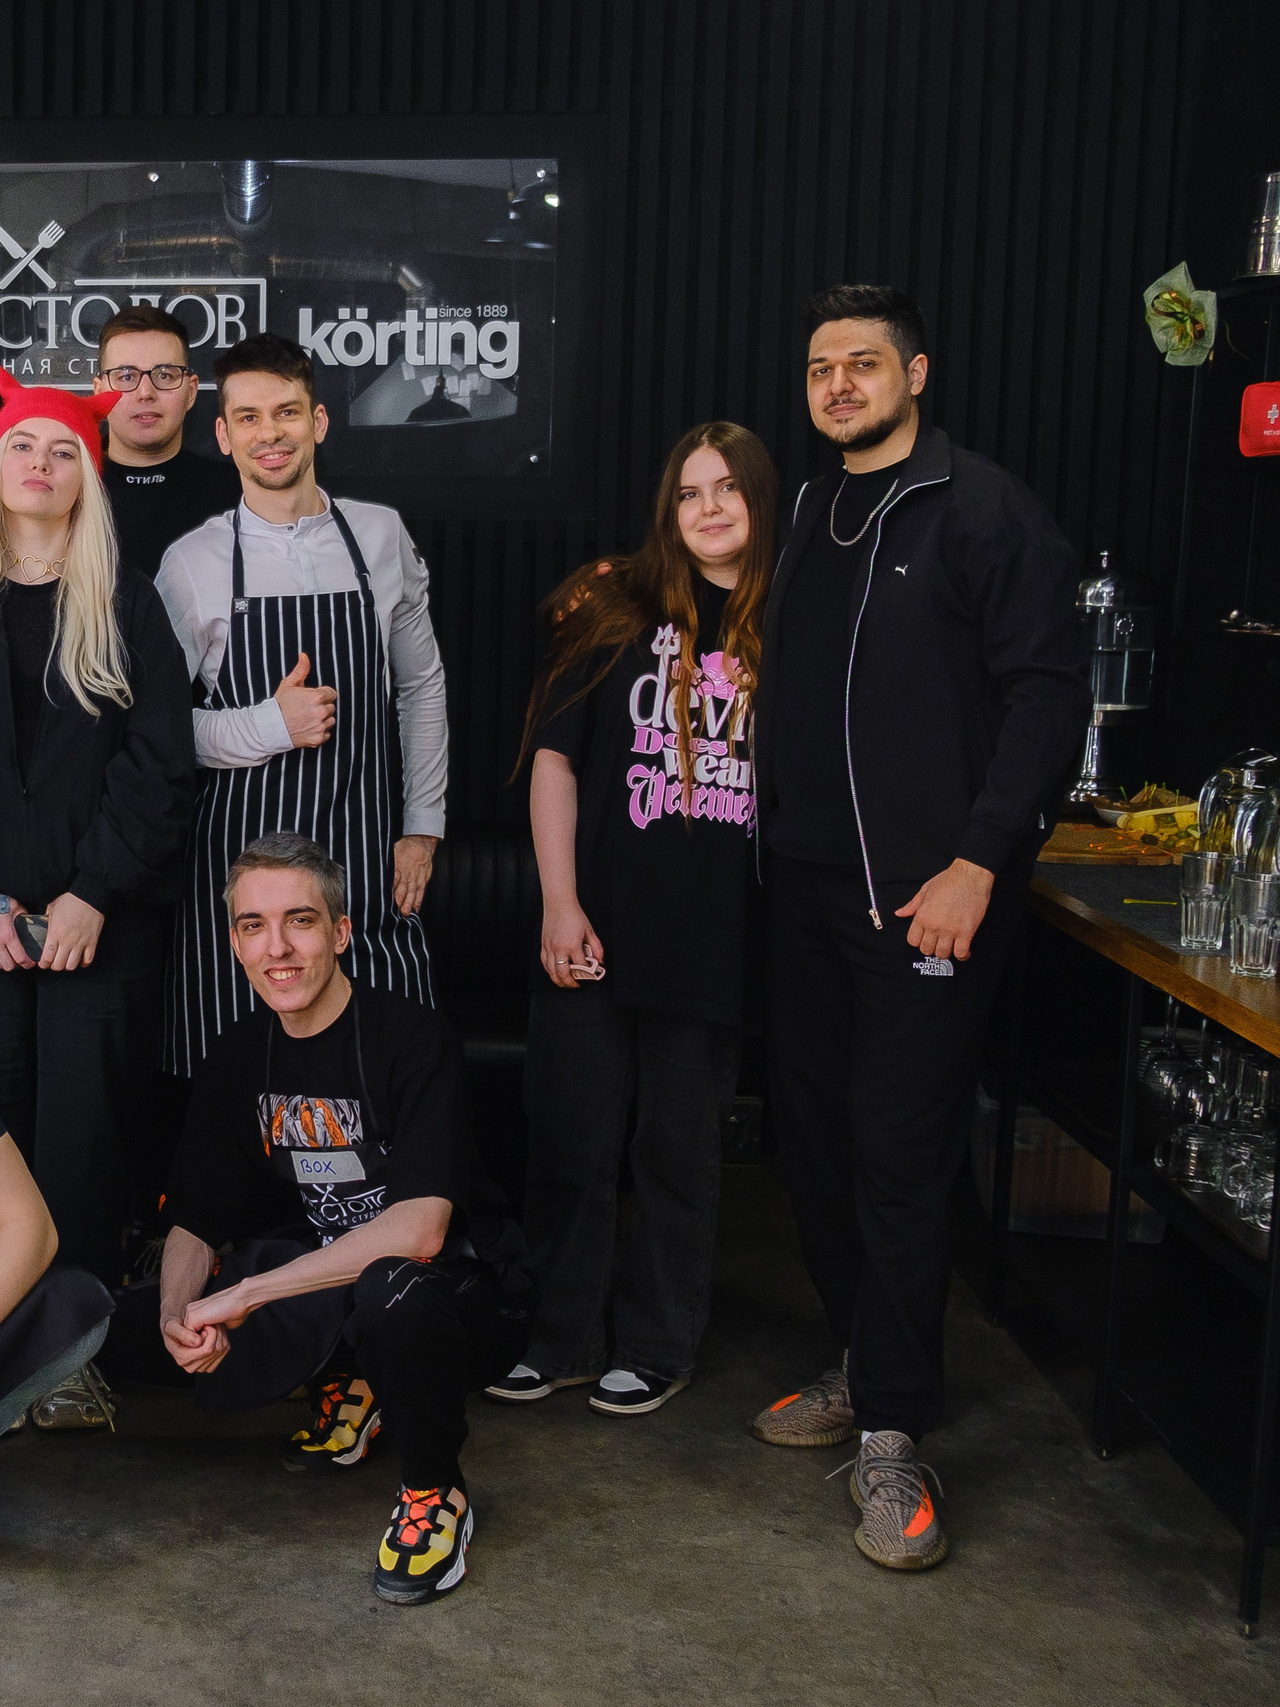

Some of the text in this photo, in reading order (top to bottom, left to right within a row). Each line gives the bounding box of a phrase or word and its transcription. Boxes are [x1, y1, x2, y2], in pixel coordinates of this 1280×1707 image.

[439, 305, 508, 317] since 1889
[299, 308, 519, 380] körting
[126, 474, 166, 485] СТИЛЬ
[912, 962, 940, 970] NORTH
[920, 968, 940, 976] FACE
